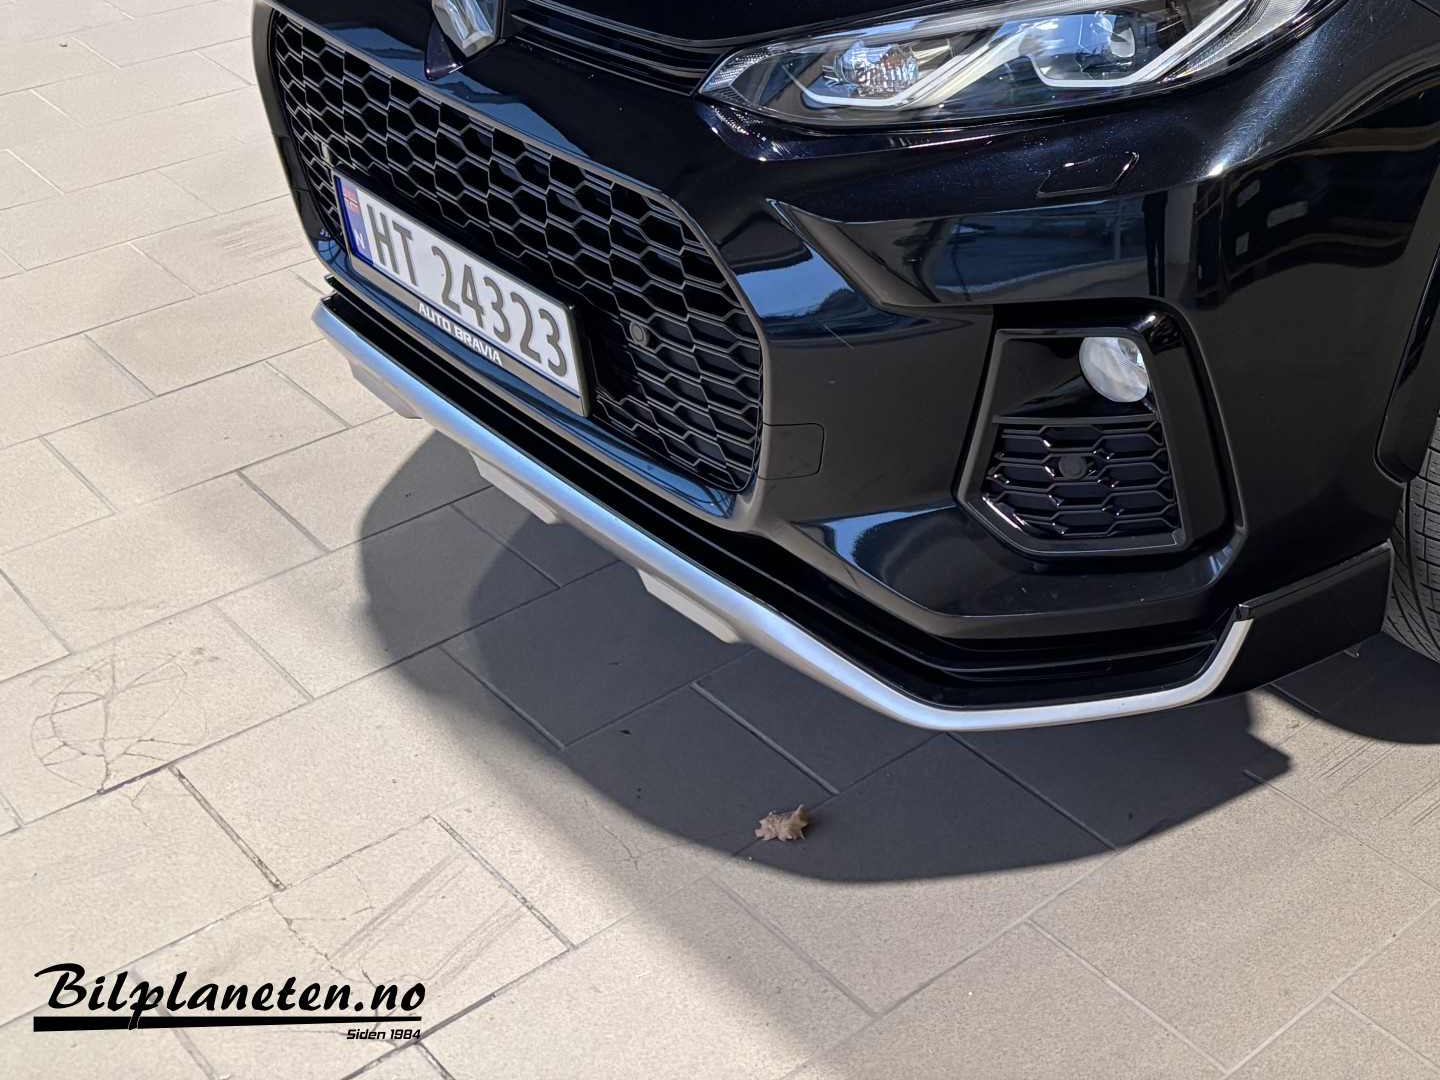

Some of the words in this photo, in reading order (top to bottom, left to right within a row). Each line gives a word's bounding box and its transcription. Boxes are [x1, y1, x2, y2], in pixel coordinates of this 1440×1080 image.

[354, 228, 366, 250] N
[366, 203, 418, 287] HT
[431, 245, 568, 377] 24323
[418, 302, 452, 336] AUTO
[454, 325, 503, 366] BRAVIA
